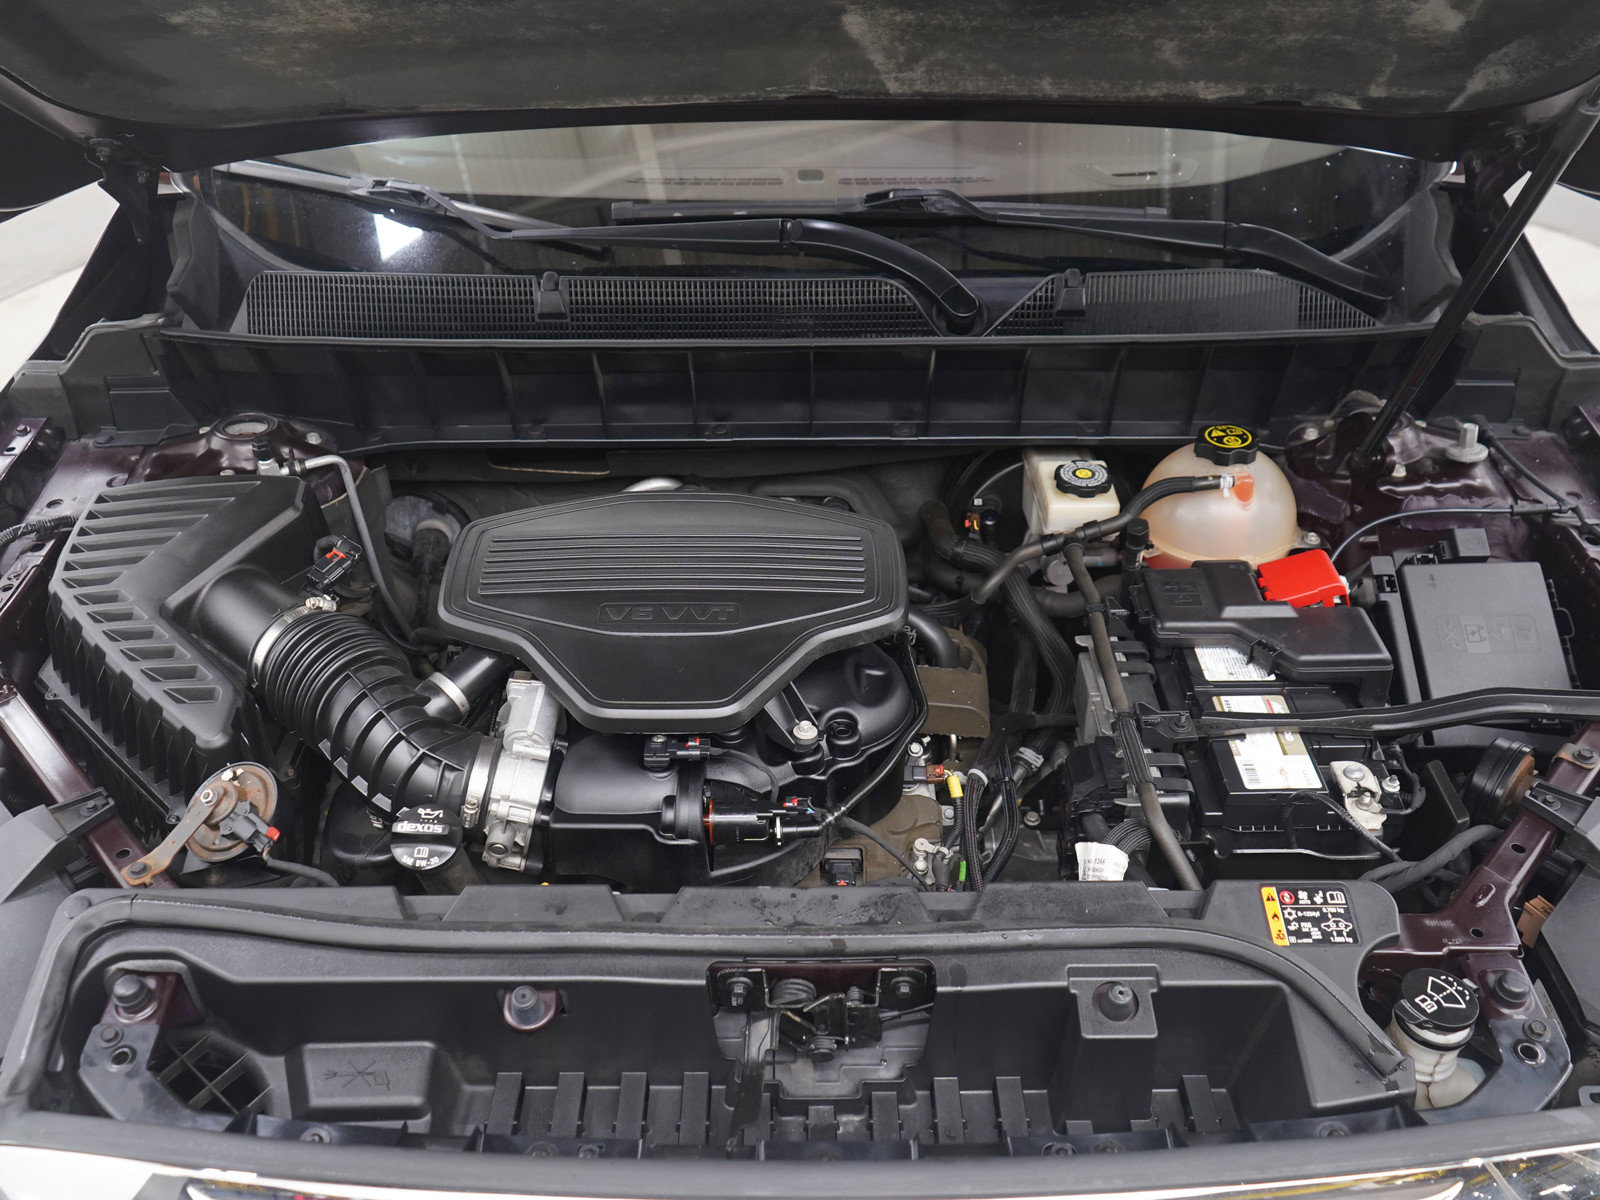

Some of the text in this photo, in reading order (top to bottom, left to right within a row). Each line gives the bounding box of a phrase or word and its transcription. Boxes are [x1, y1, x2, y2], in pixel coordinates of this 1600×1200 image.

[605, 606, 735, 621] V6 VVT
[396, 820, 444, 834] dexos
[401, 855, 439, 867] SAE 5W-30
